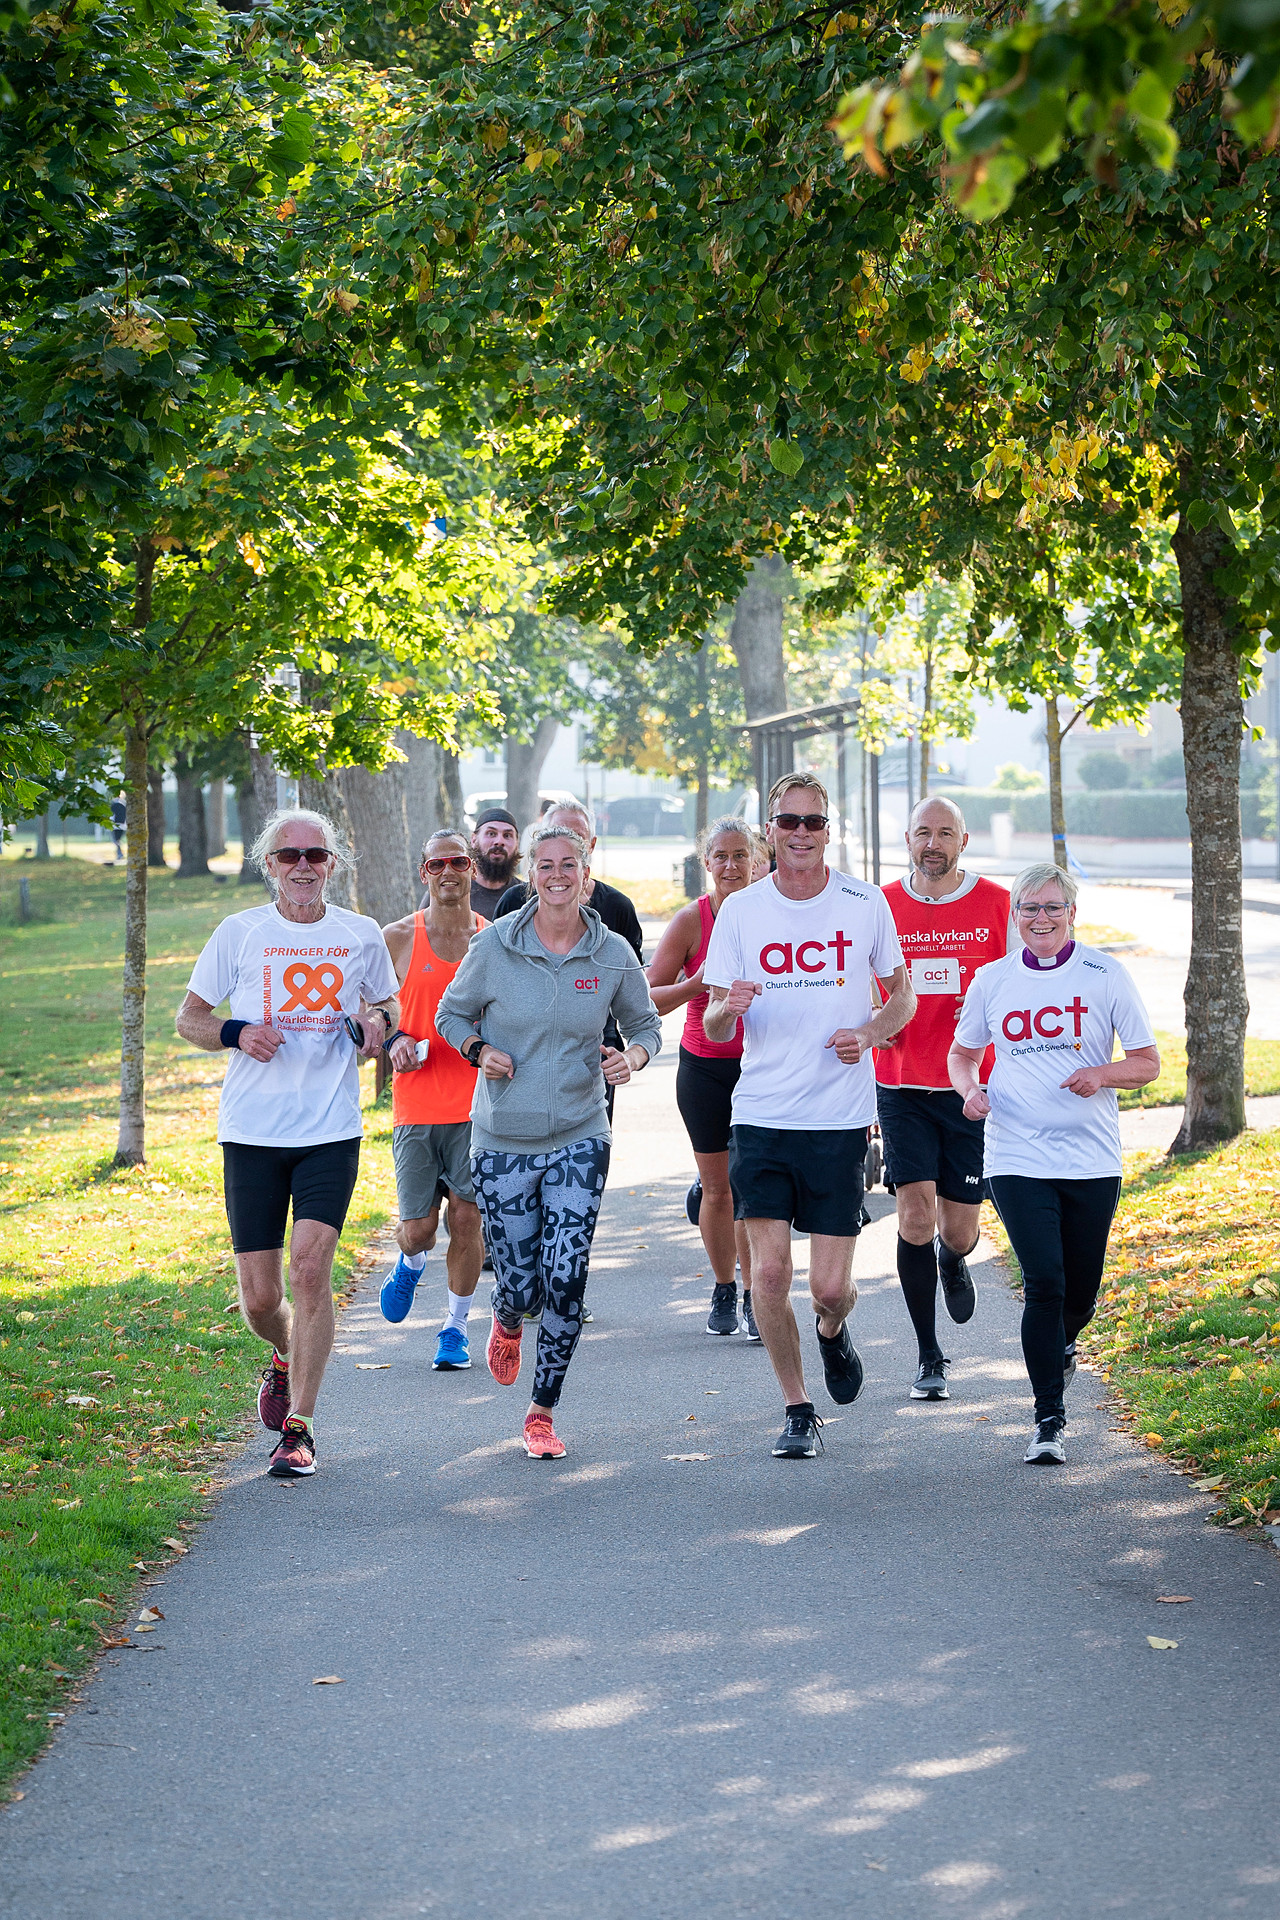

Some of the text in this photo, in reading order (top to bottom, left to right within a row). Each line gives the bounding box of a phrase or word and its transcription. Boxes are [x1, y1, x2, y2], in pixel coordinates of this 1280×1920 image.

[841, 887, 865, 899] CRAFT
[897, 929, 974, 945] enska kyrkan
[263, 945, 350, 958] SPRINGER FÖR
[759, 930, 853, 975] act
[901, 944, 940, 953] NATIONELLT
[1082, 960, 1104, 972] CRAFT
[923, 968, 950, 981] act
[574, 976, 600, 990] act
[765, 978, 835, 990] Church of Sweden
[263, 965, 273, 1028] KSINSAMLINGEN
[1002, 996, 1089, 1042] act
[1010, 1045, 1036, 1057] Church
[1036, 1044, 1044, 1053] of
[965, 1175, 979, 1185] HH
